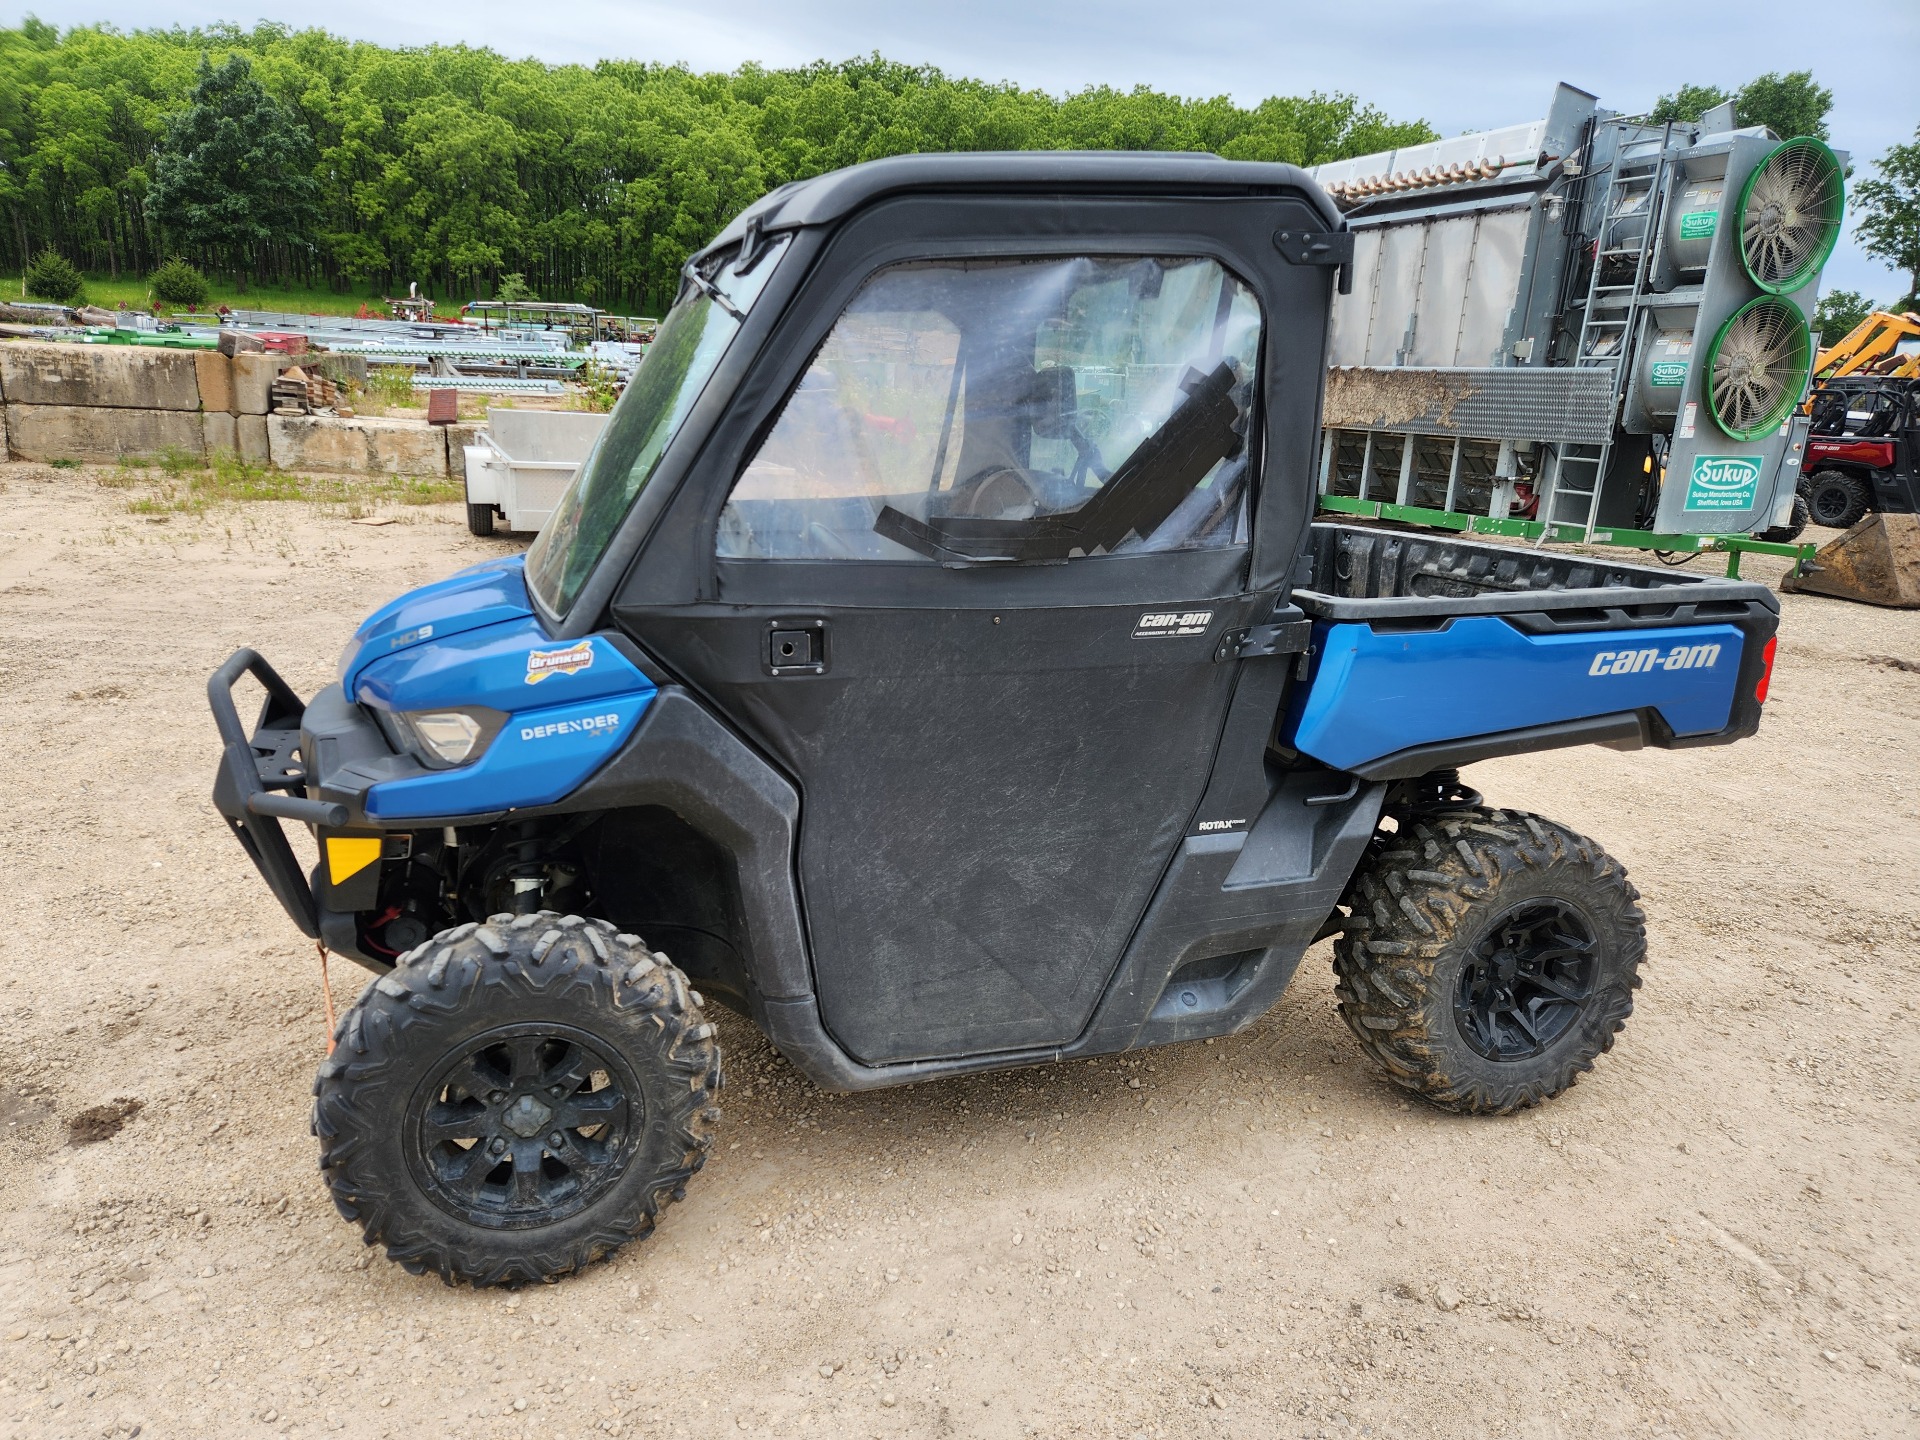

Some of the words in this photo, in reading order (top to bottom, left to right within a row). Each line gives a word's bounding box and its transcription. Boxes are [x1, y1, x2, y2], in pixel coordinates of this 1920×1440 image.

[1686, 215, 1713, 228] Sukup
[1656, 364, 1684, 376] Sukup
[1700, 460, 1752, 486] Sukup
[1692, 491, 1708, 499] Sukup
[1708, 491, 1742, 499] Manufacturing
[1140, 613, 1211, 627] can-am
[530, 652, 590, 669] Brunkan
[1588, 644, 1721, 676] can-am
[521, 714, 619, 740] DEFENDER
[588, 726, 619, 738] XT
[1199, 820, 1232, 830] ROTAX
